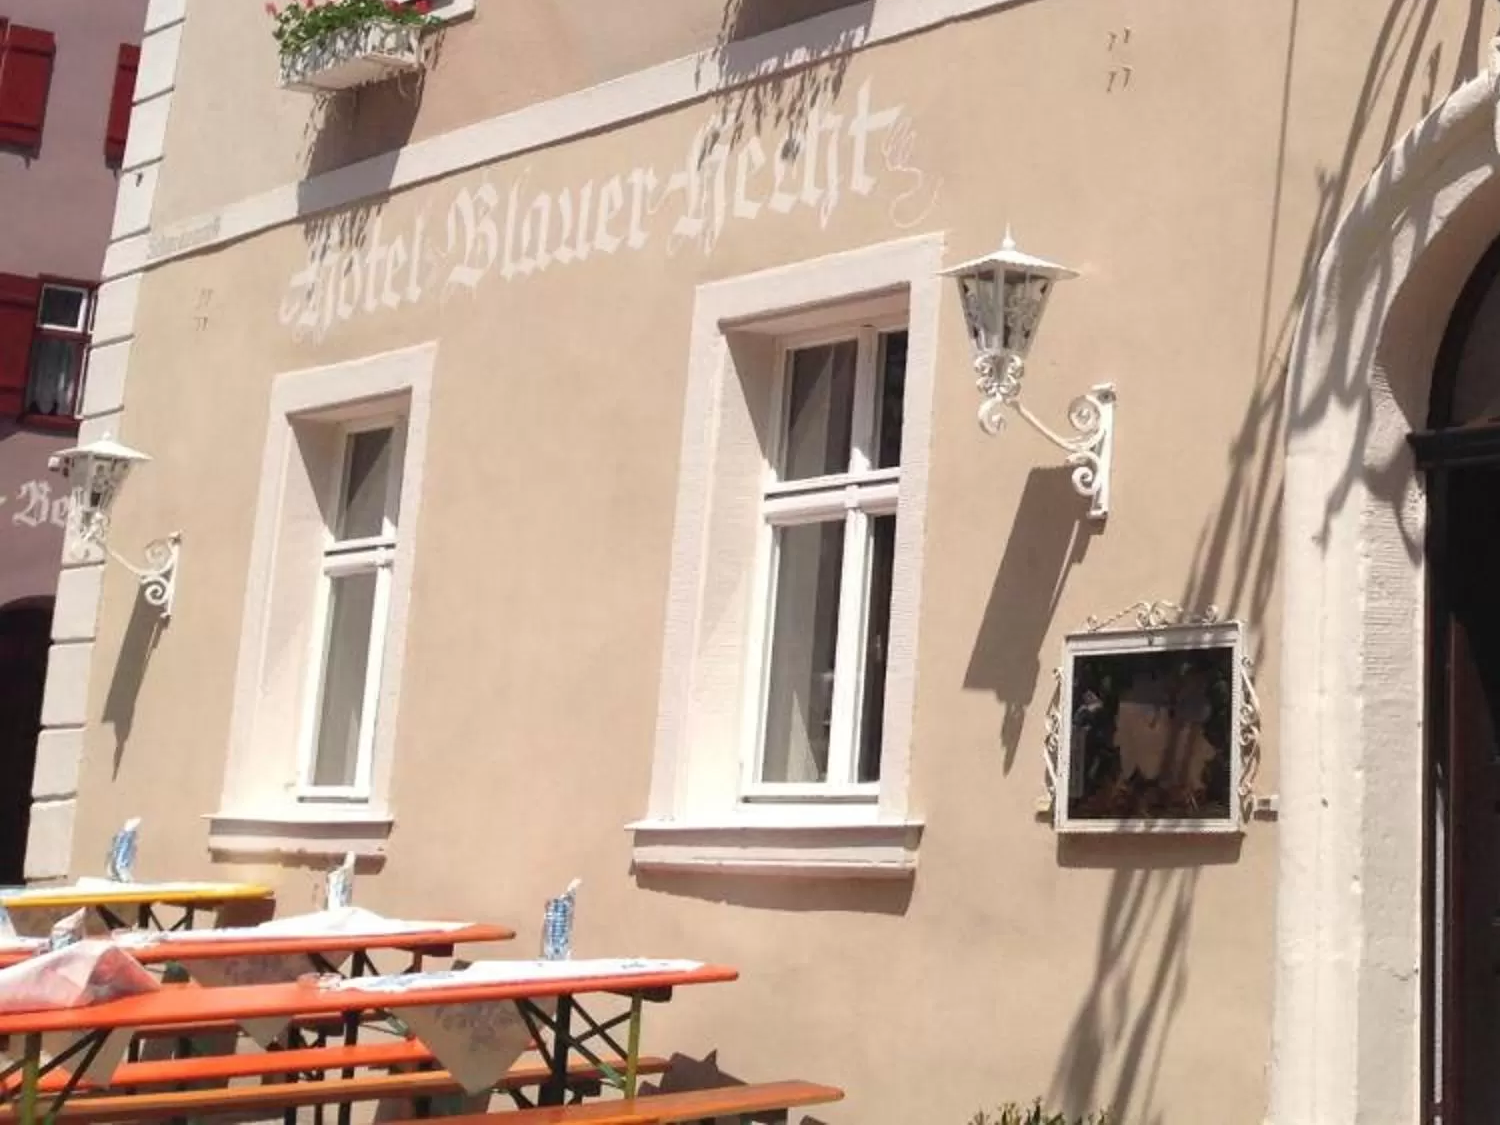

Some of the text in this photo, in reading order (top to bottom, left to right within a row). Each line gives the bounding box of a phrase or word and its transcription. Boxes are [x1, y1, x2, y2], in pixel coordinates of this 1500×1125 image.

[278, 76, 905, 343] Hotel Blauer Hecht
